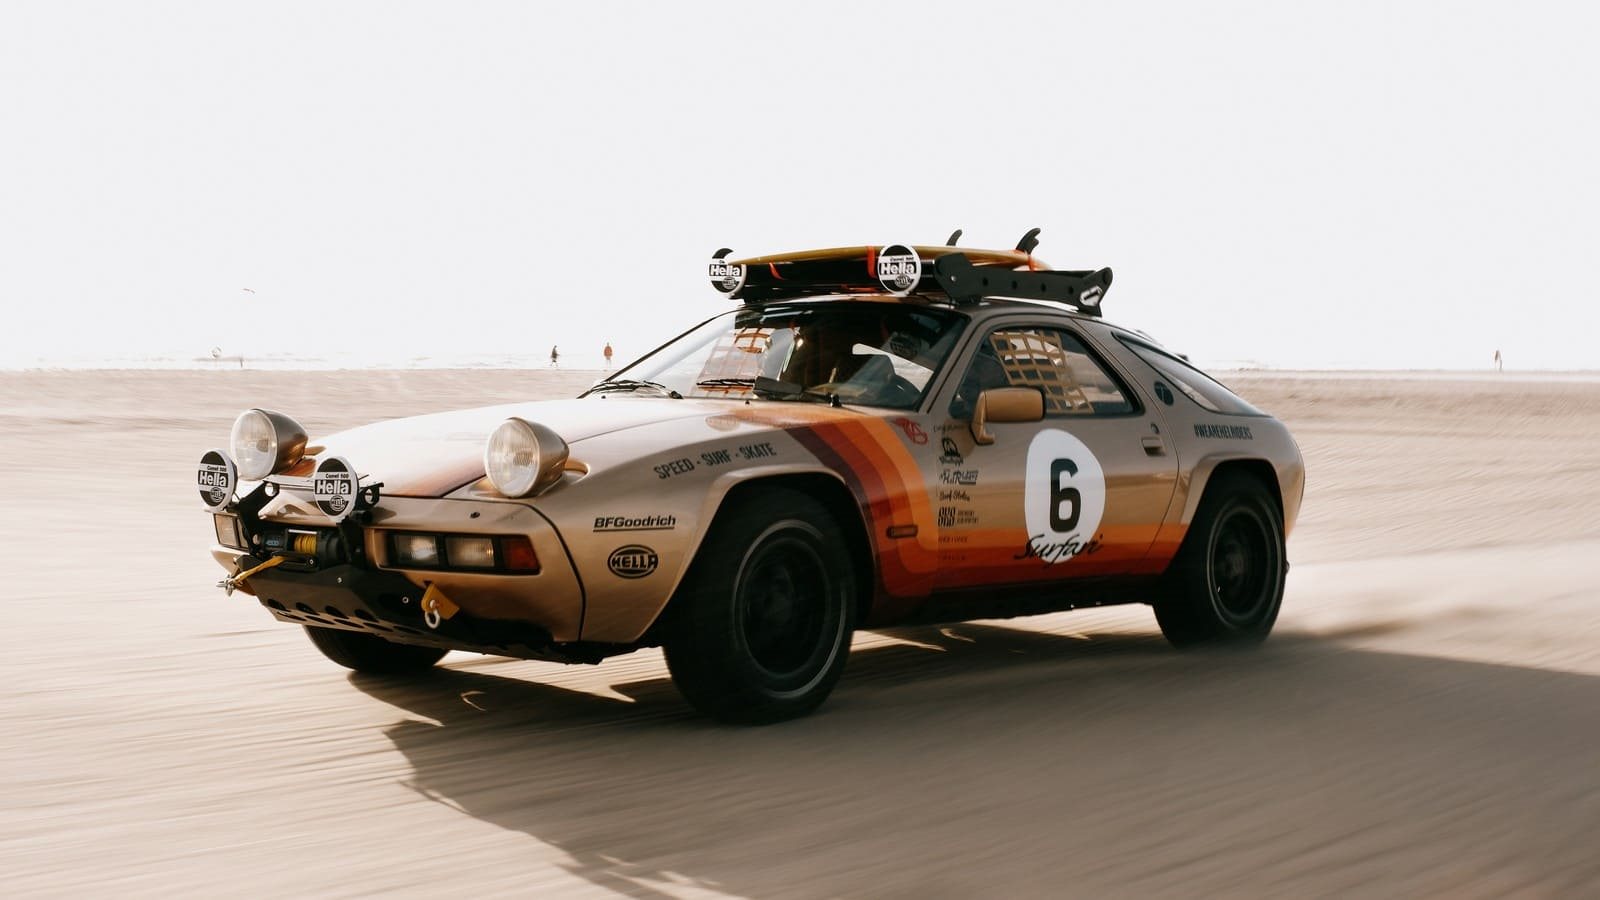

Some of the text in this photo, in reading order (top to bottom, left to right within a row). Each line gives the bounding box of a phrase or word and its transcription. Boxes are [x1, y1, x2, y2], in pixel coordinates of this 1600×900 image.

[710, 264, 741, 276] Hella
[881, 262, 915, 275] Hella
[653, 442, 777, 480] SPEED SURF SKATE
[199, 471, 227, 488] Hella
[316, 480, 350, 494] Hella
[1049, 458, 1081, 533] 6
[593, 515, 676, 528] BFGoodrich
[1013, 533, 1104, 569] Surfari
[610, 553, 659, 569] HELLA
